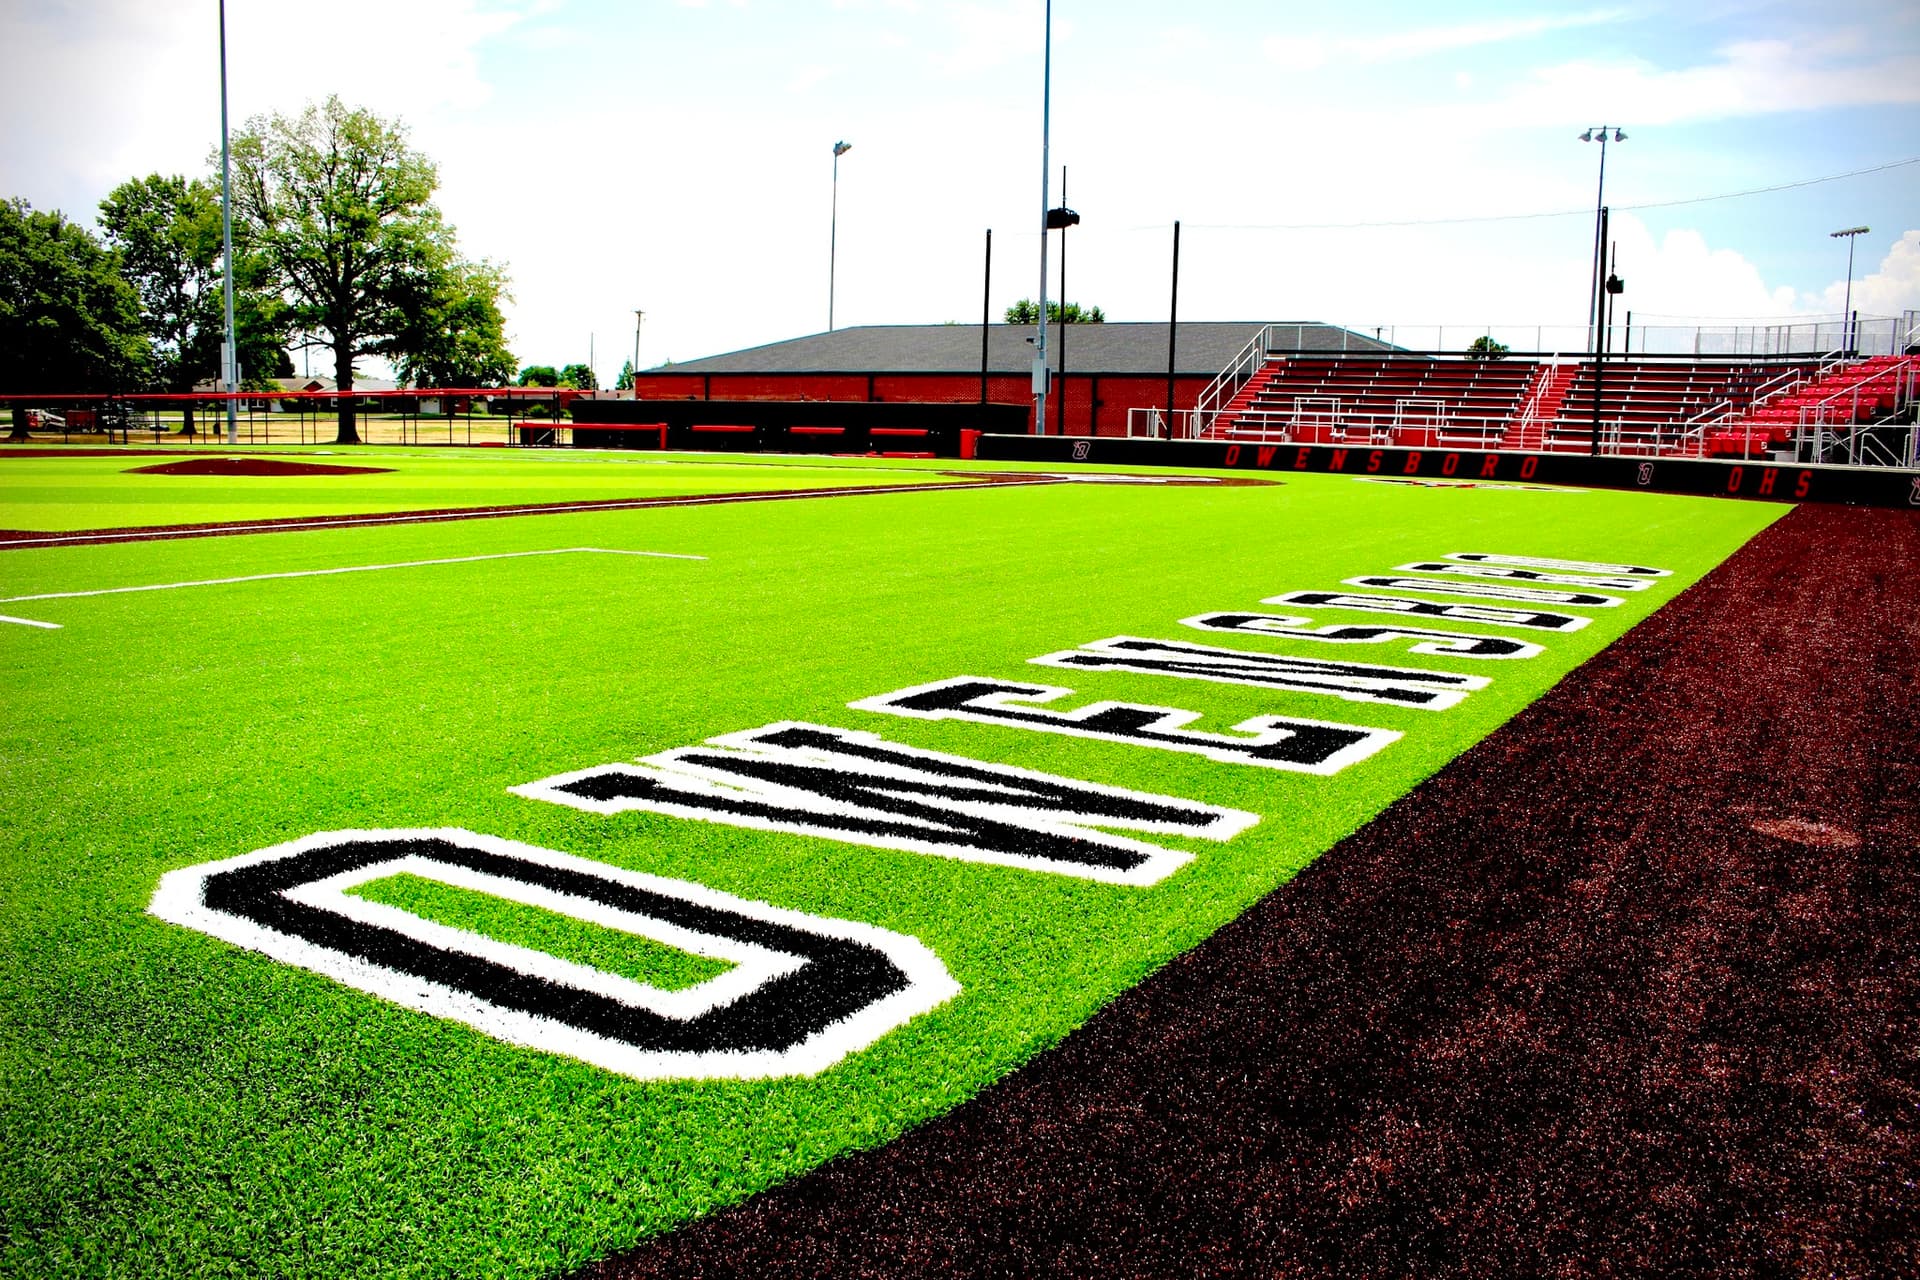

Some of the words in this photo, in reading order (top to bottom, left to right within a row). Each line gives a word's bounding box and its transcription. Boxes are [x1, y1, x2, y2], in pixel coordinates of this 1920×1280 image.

[1225, 445, 1539, 479] OWENSBORO
[1727, 465, 1813, 498] OHS
[147, 552, 1674, 1083] OWENSBORO
